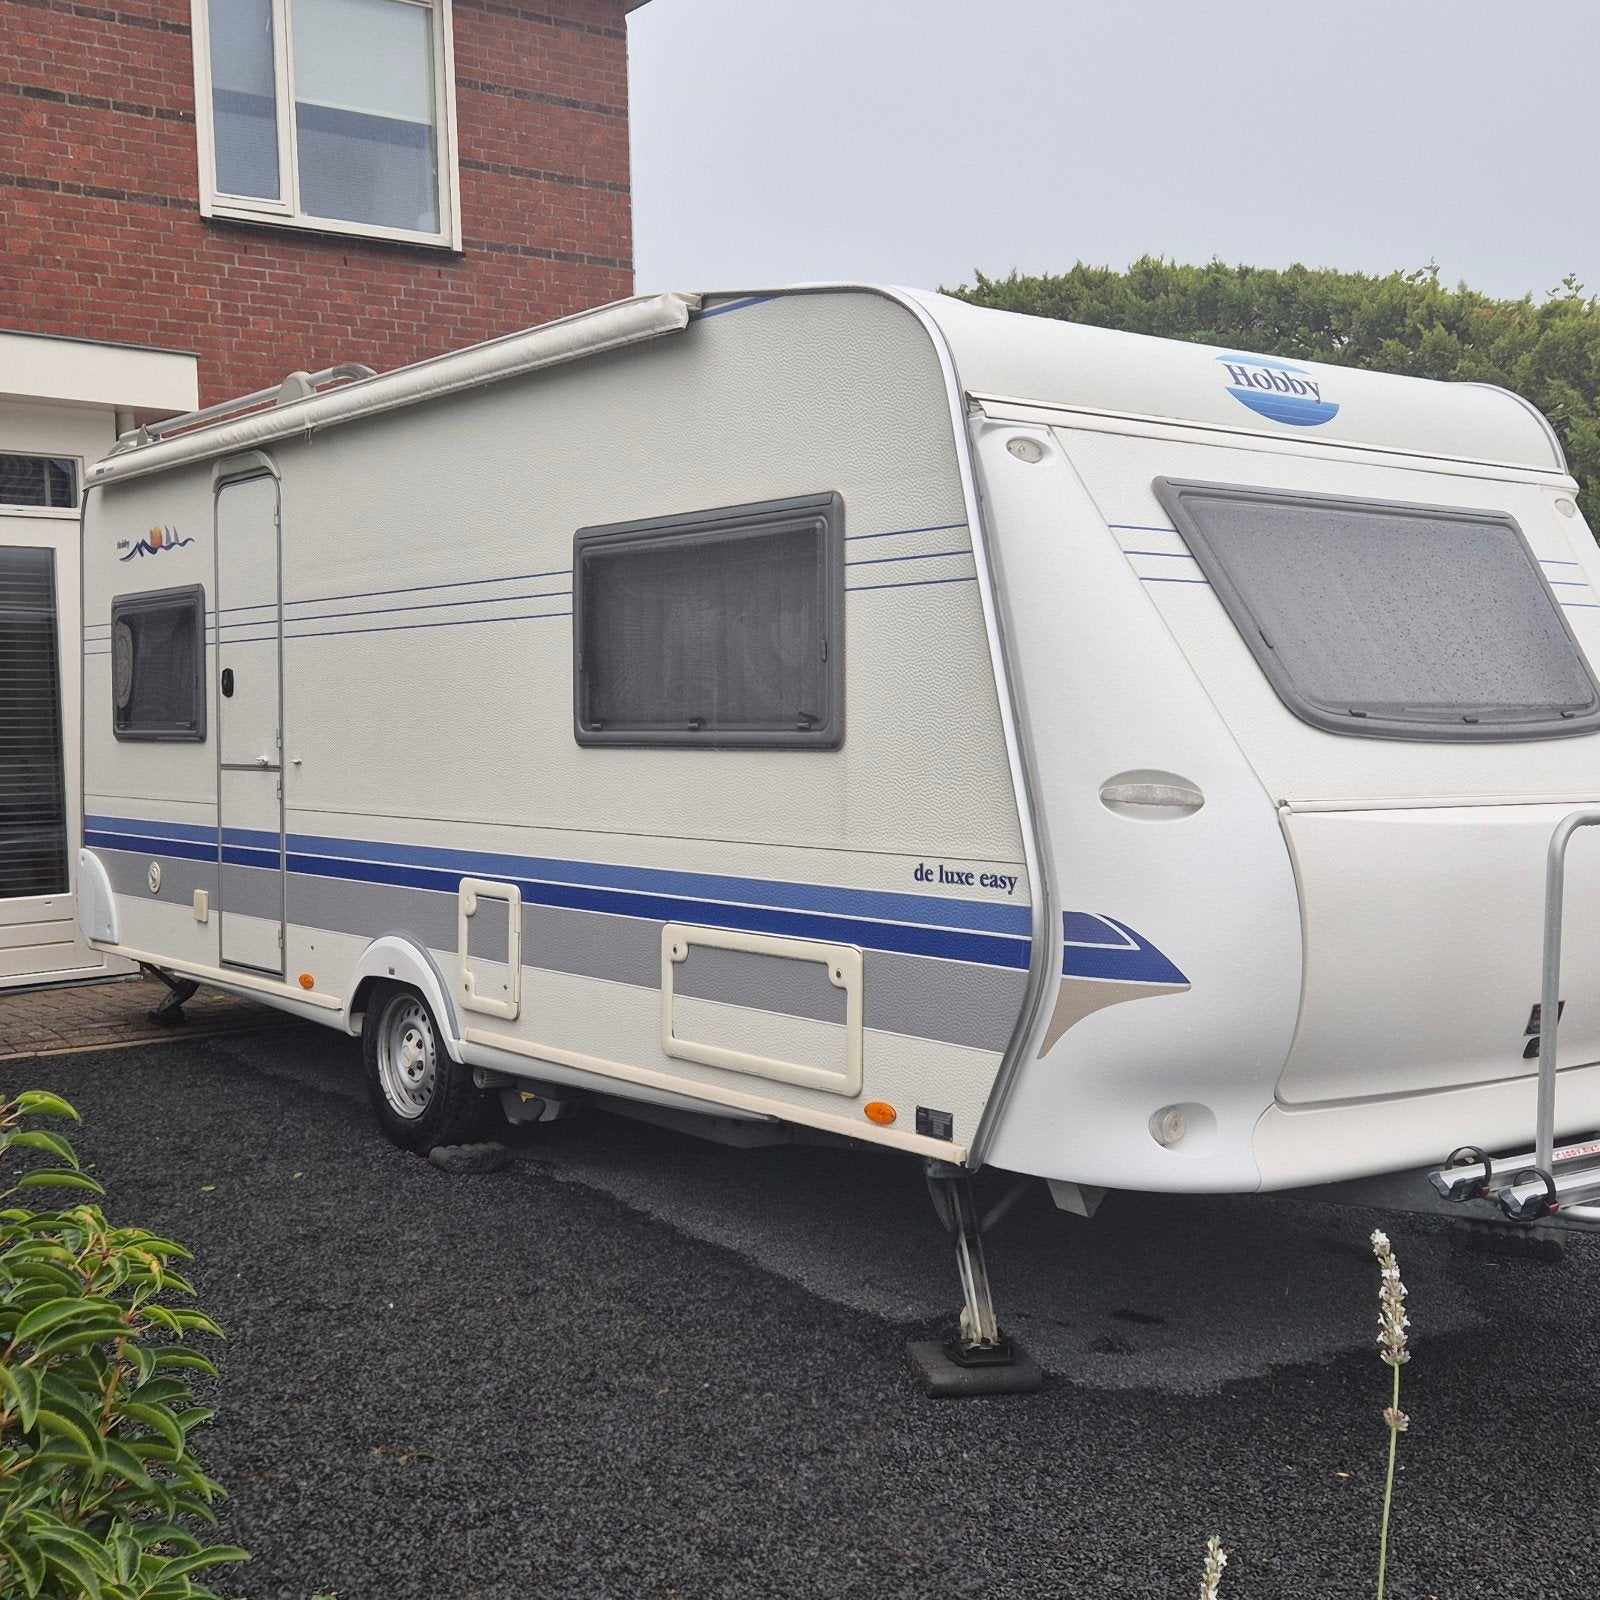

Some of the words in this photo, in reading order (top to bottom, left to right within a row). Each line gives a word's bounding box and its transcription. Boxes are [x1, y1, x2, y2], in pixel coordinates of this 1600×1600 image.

[1222, 363, 1321, 404] Hobby
[914, 863, 934, 882] de
[938, 864, 974, 886] luxe
[979, 873, 1018, 895] easy
